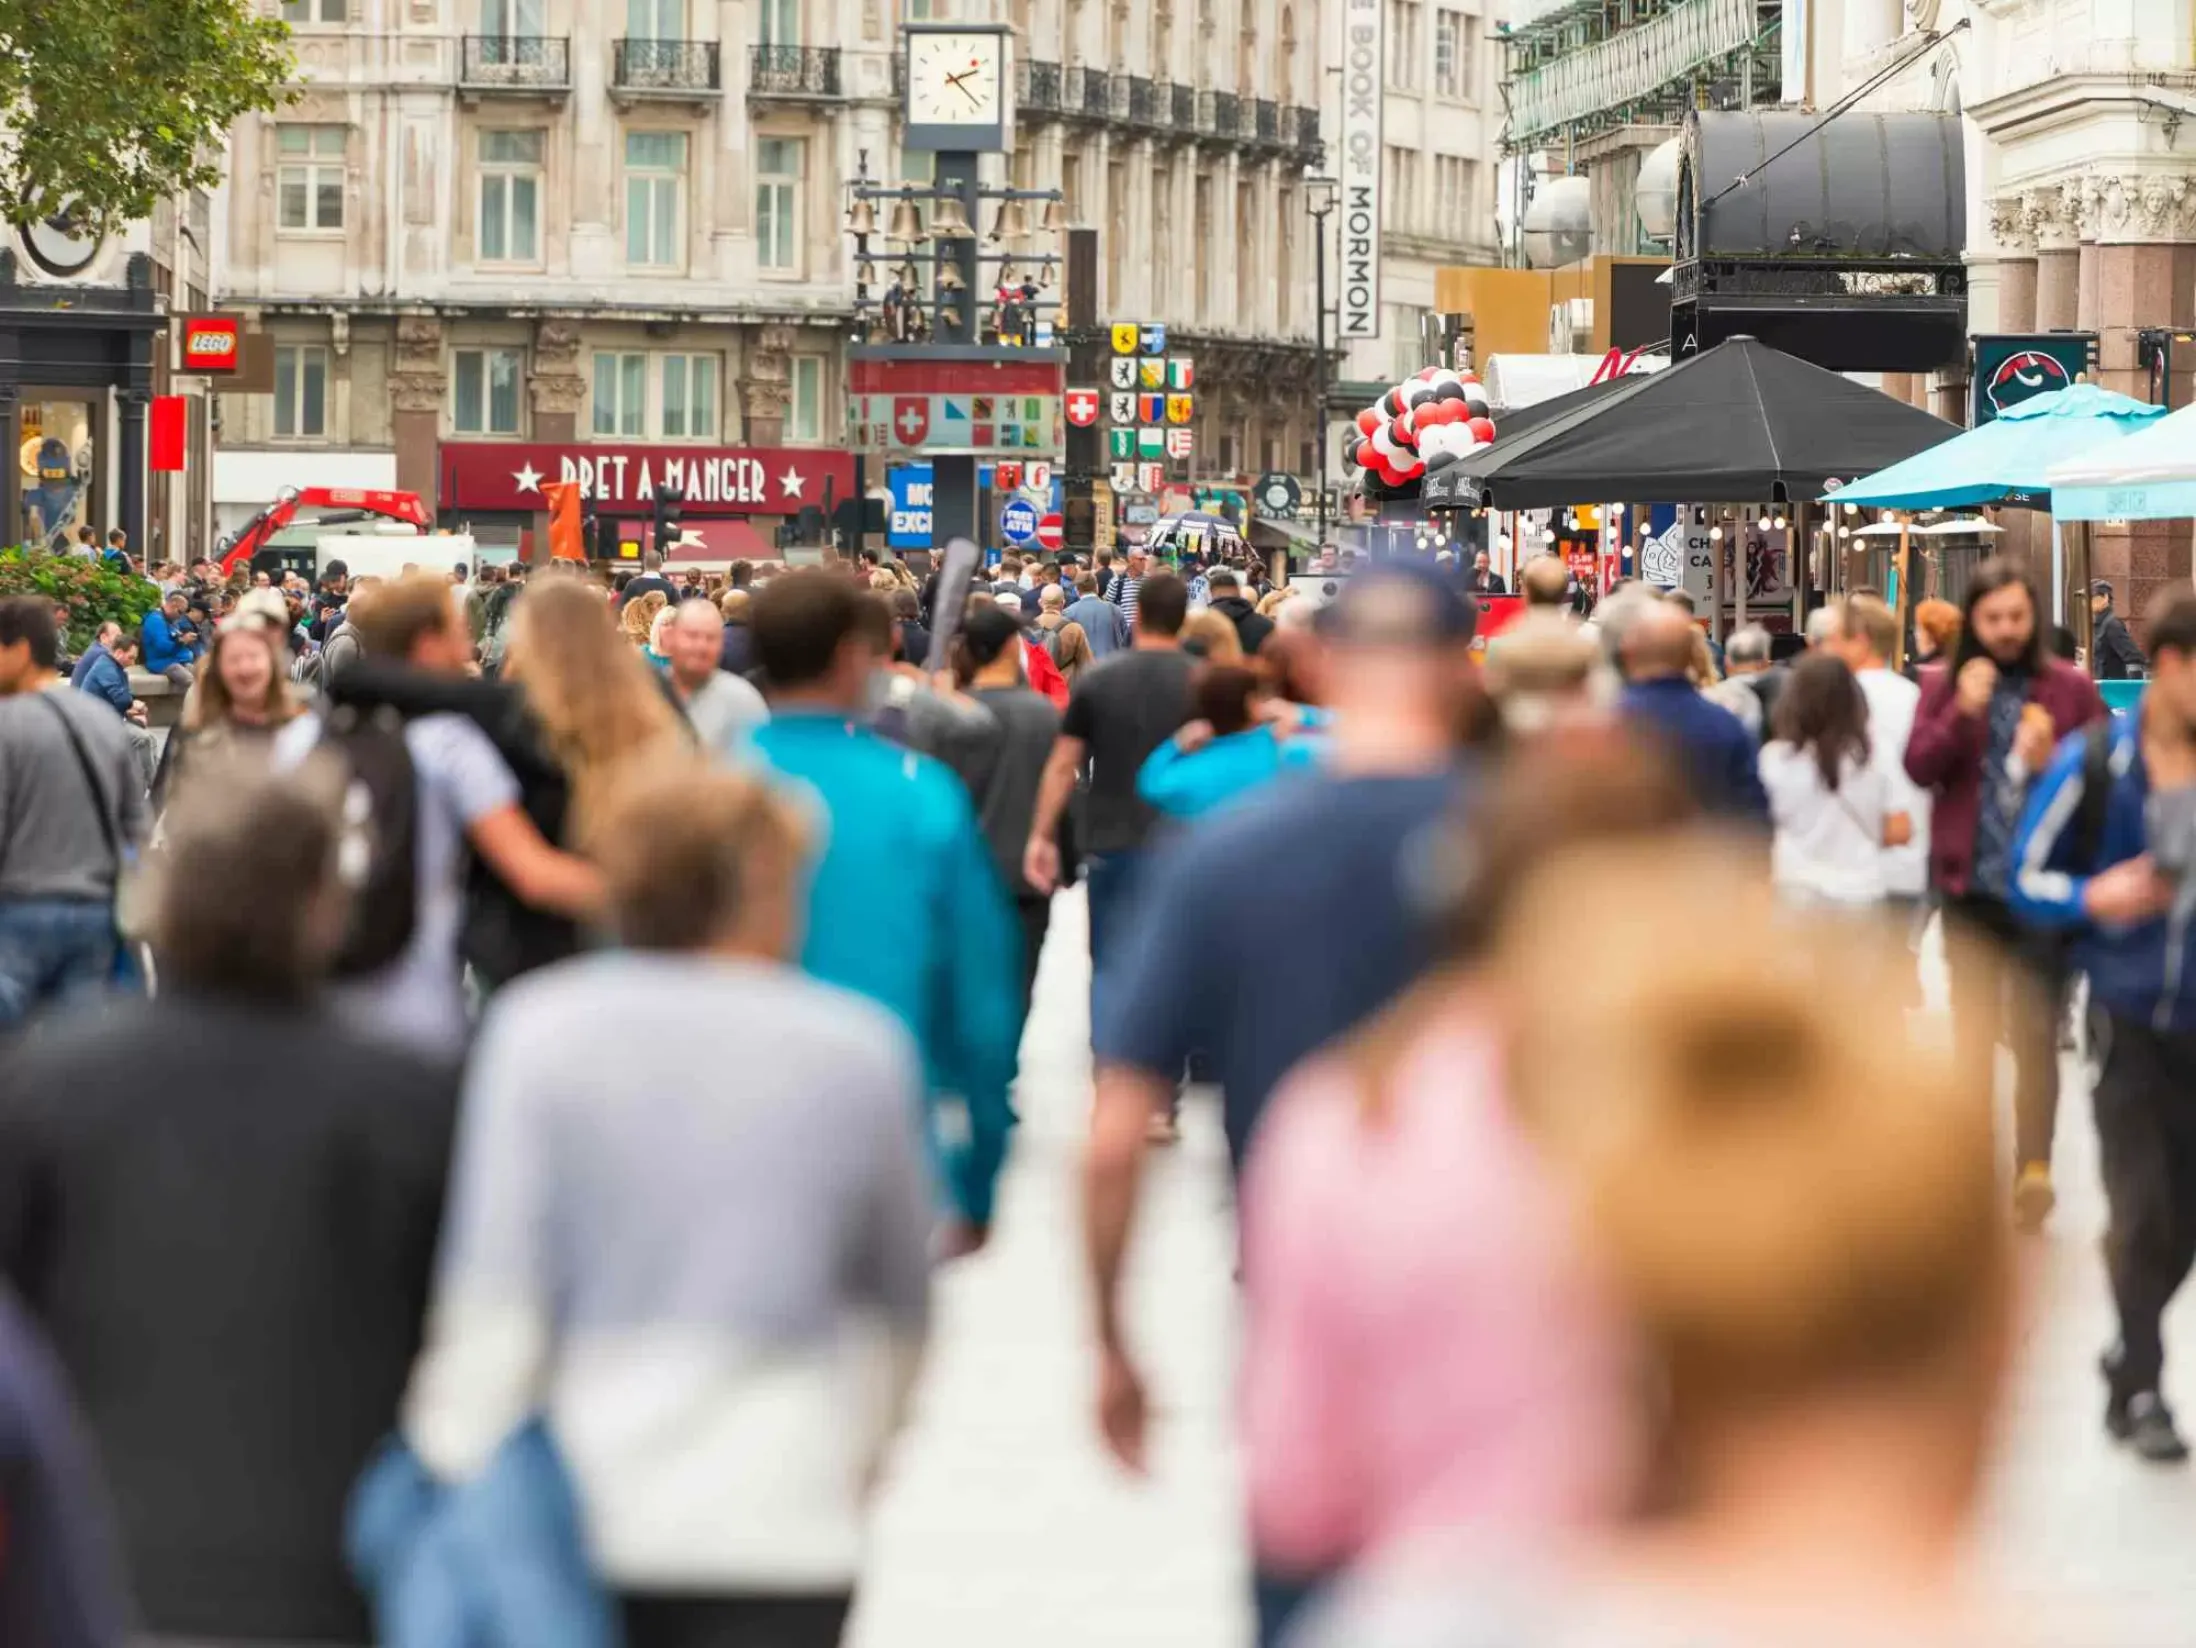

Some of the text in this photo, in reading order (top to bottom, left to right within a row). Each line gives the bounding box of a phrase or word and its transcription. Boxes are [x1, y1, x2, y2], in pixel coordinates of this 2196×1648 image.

[1349, 25, 1375, 119] BOOK
[1348, 129, 1373, 175] OF
[1347, 186, 1372, 332] MORMON
[190, 332, 231, 353] LEGO
[560, 455, 767, 503] PRET A MANGER
[1688, 536, 1714, 549] CH
